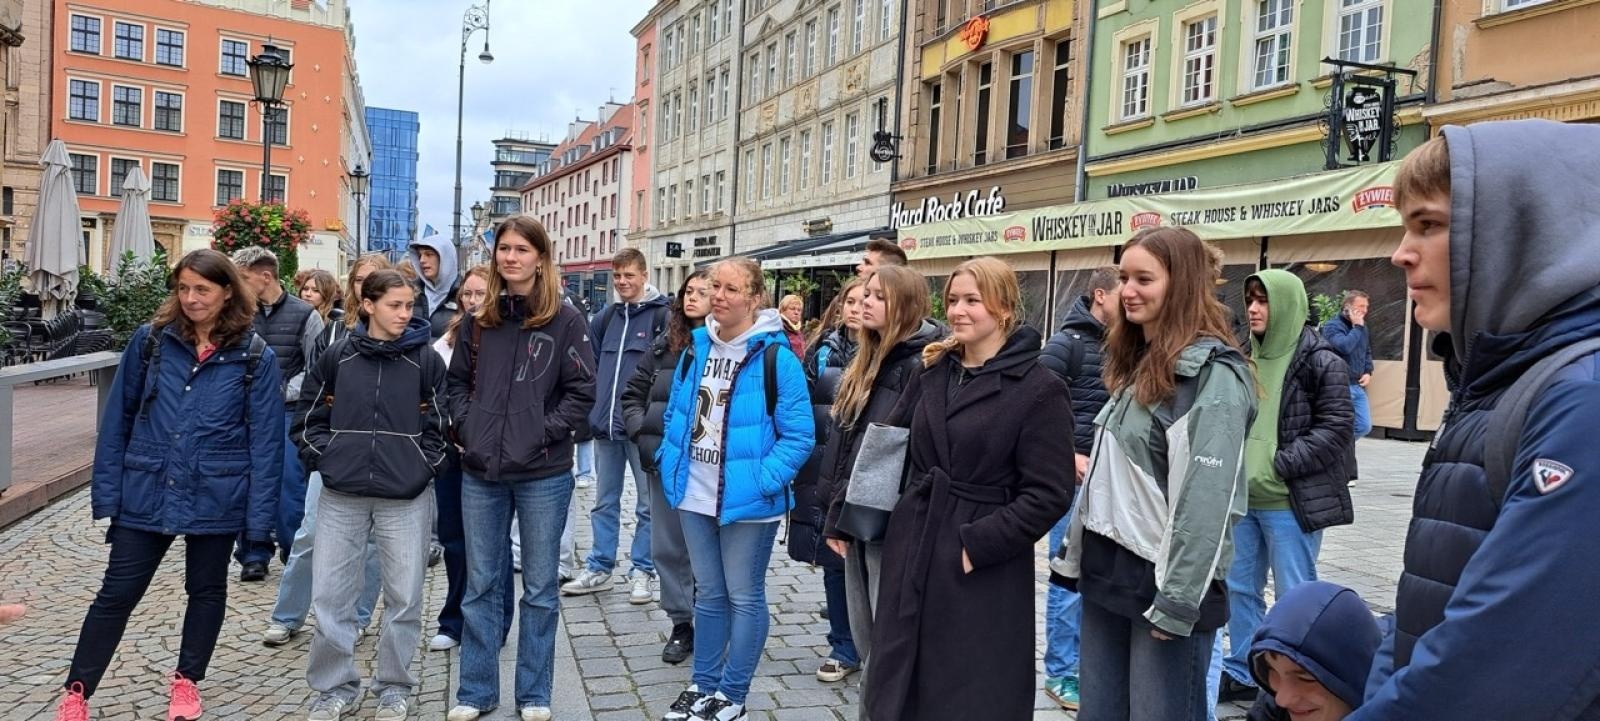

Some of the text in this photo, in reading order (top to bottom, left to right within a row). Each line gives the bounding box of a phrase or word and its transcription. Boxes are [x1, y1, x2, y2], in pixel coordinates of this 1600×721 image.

[890, 198, 926, 230] Hard
[926, 192, 962, 223] Rock
[1170, 196, 1340, 226] STEAK HOUSE & WHISKEY JARS
[958, 232, 983, 245] WHISKEY
[1032, 214, 1087, 242] WHISKEY
[1097, 211, 1123, 236] JAR
[689, 445, 721, 465] CHOO
